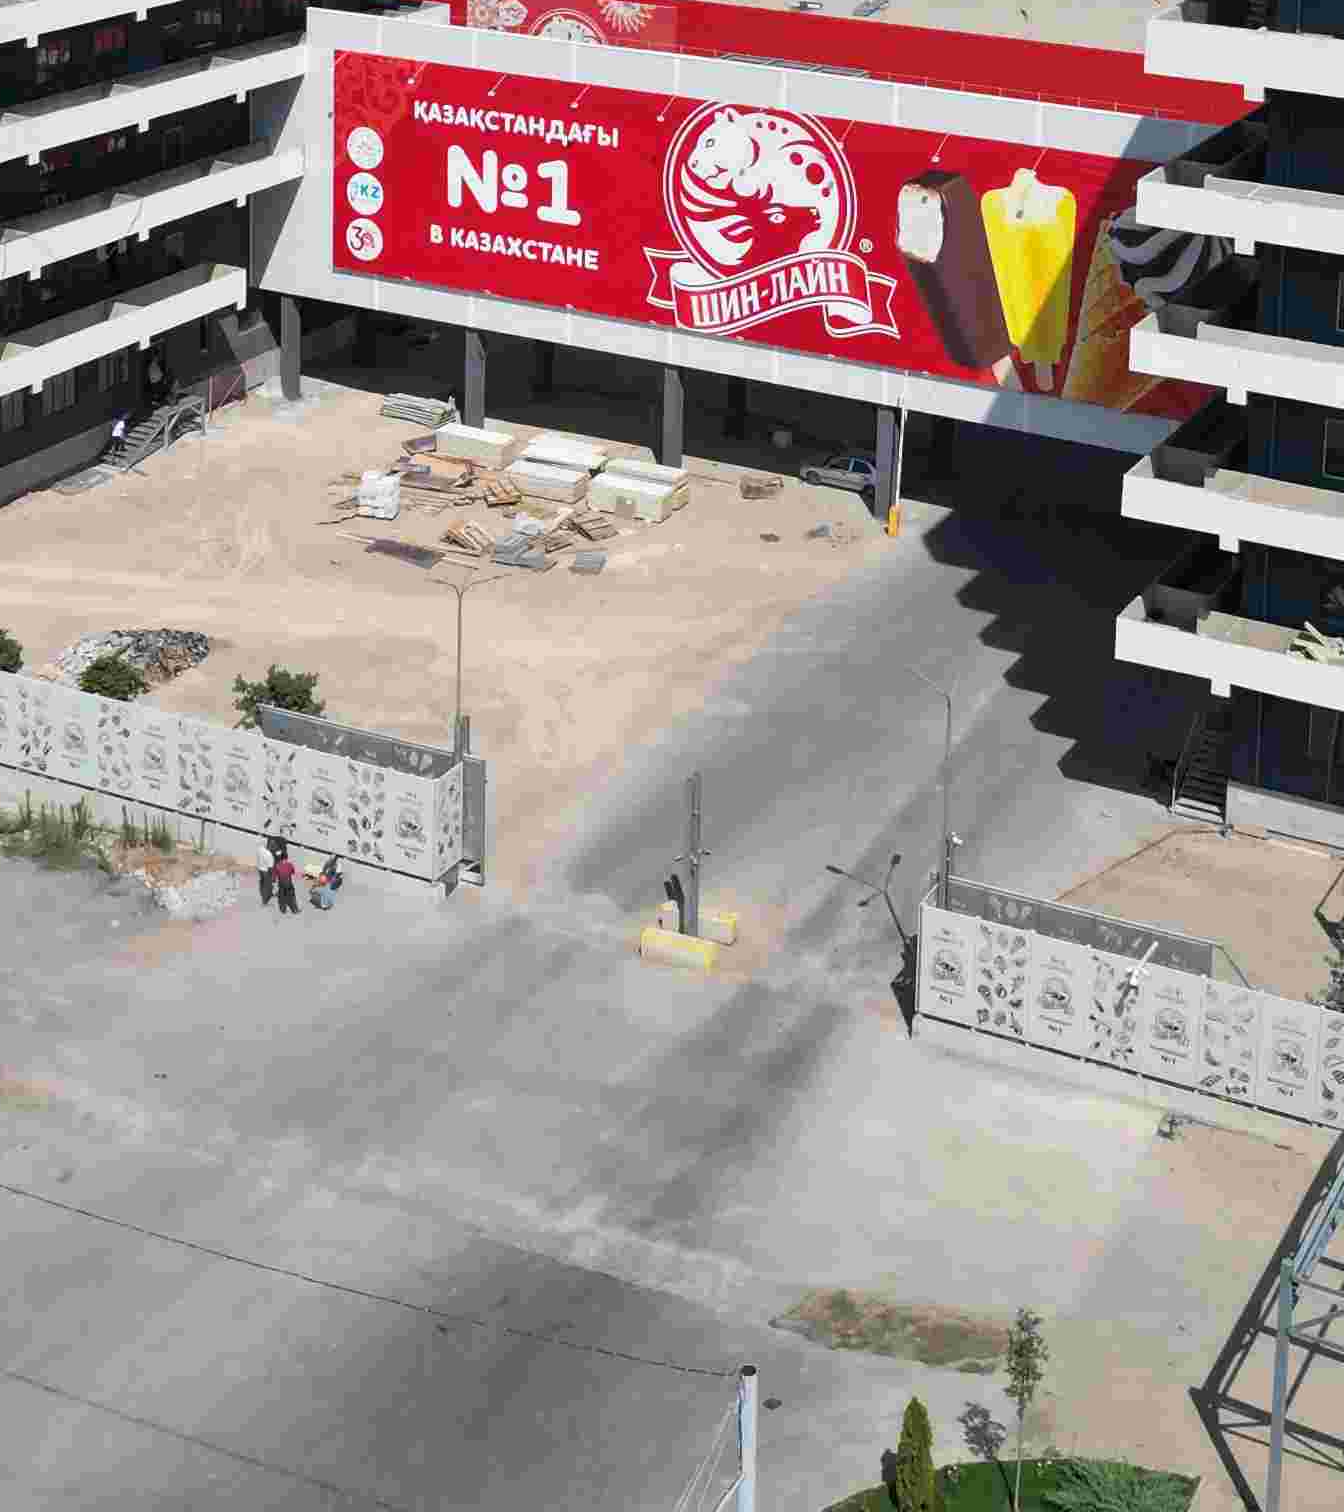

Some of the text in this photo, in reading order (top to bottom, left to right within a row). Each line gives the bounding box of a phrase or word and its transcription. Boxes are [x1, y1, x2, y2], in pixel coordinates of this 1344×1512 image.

[413, 100, 620, 149] ҚАЗАҚСТАНДАҒЫ
[429, 223, 600, 271] В КАЗАХСТАНЕ
[690, 258, 850, 327] ШИН-ЛАЙН
